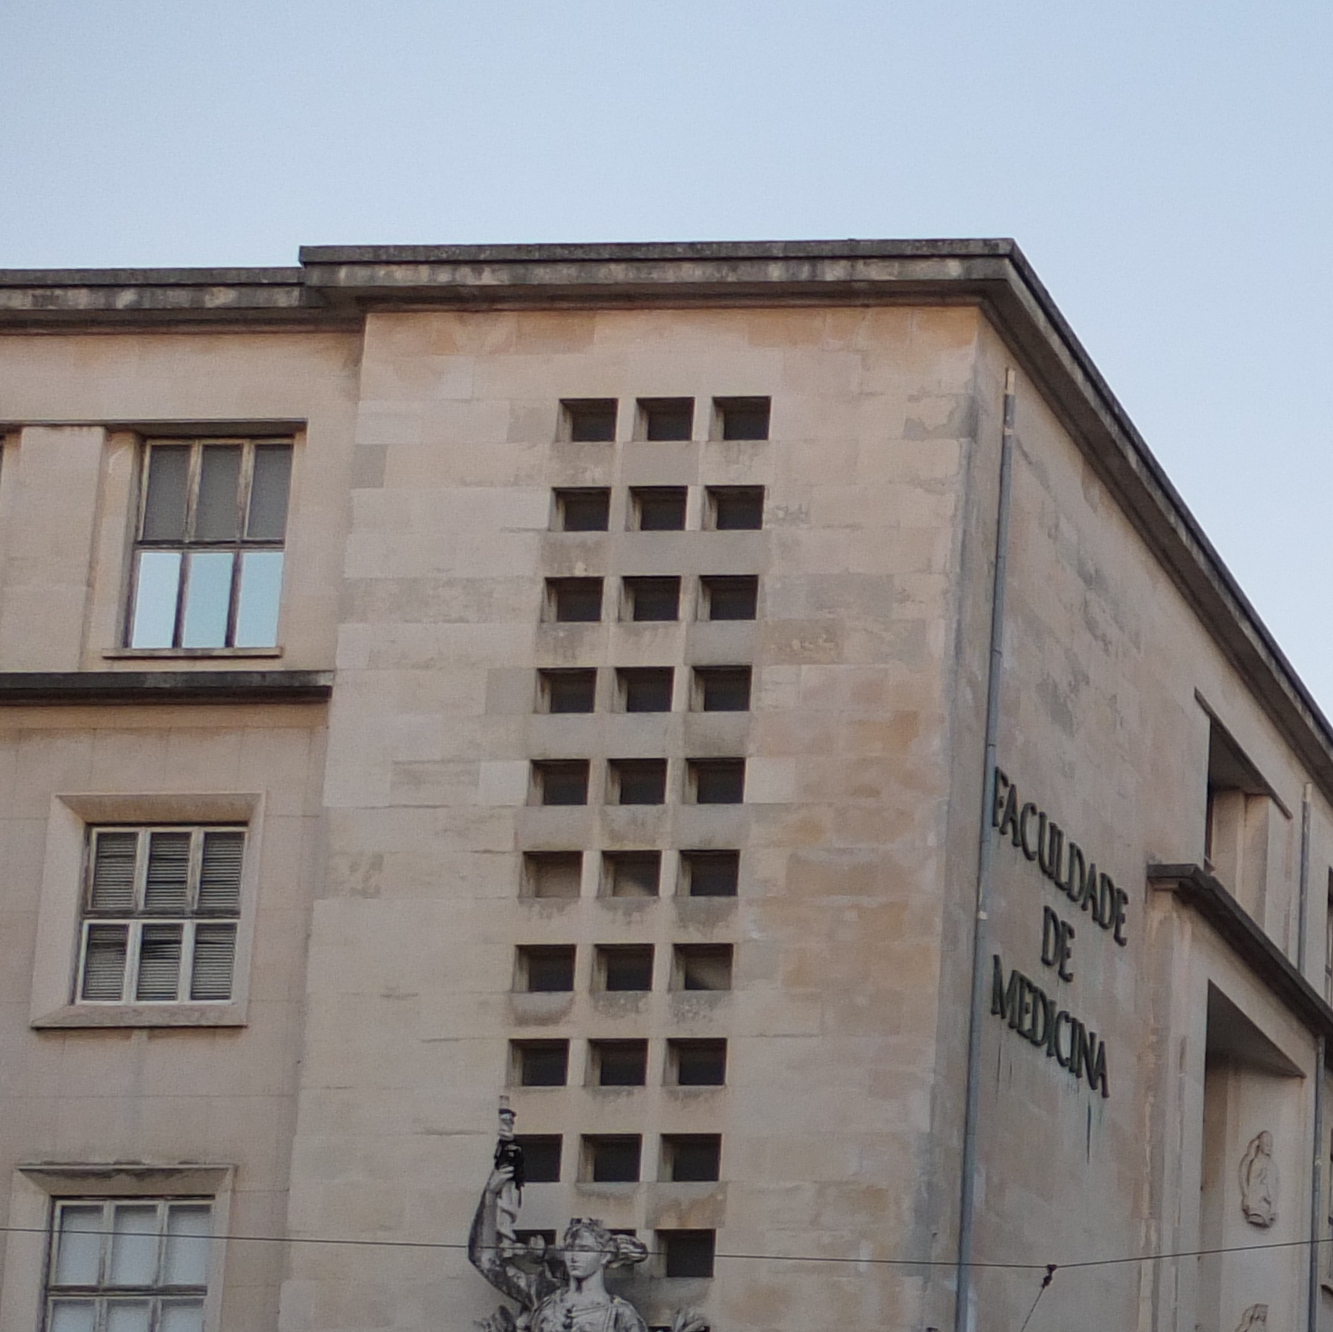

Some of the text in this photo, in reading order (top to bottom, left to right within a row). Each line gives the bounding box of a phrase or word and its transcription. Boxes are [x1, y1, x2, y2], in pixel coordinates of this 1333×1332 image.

[992, 765, 1129, 947] FACULDADE
[1041, 905, 1075, 982] DE
[991, 954, 1110, 1099] MEDICINA
